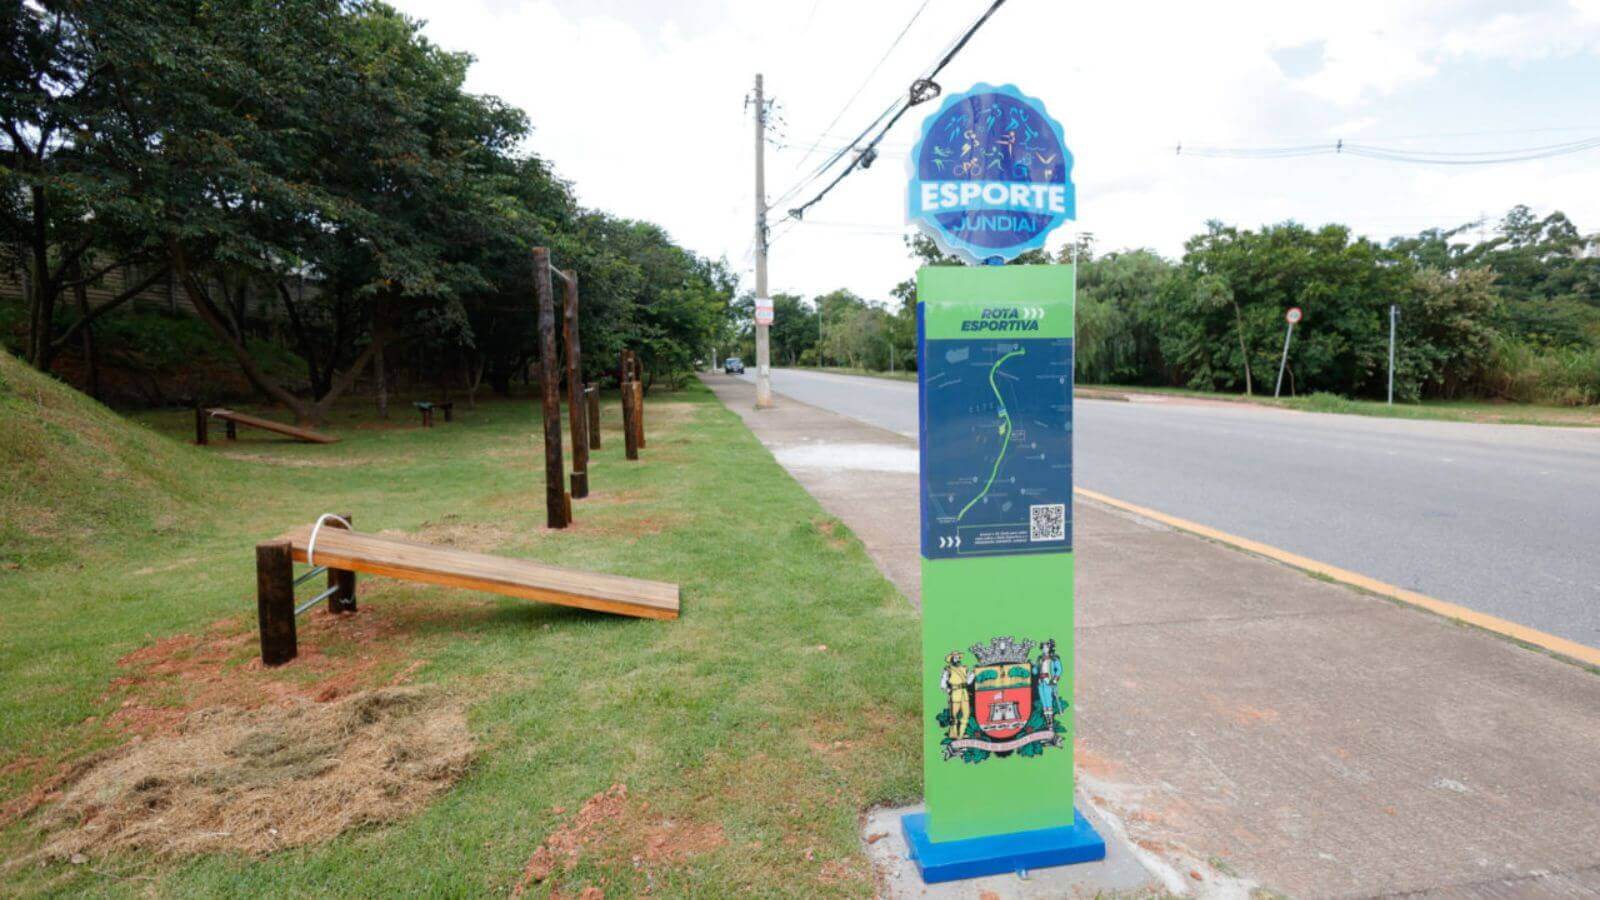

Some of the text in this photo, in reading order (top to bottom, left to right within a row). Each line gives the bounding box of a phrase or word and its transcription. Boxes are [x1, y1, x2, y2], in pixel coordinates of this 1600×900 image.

[921, 183, 1065, 212] ESPORTE
[981, 308, 1019, 319] ROTA
[961, 320, 1039, 331] ESPORTIVA
